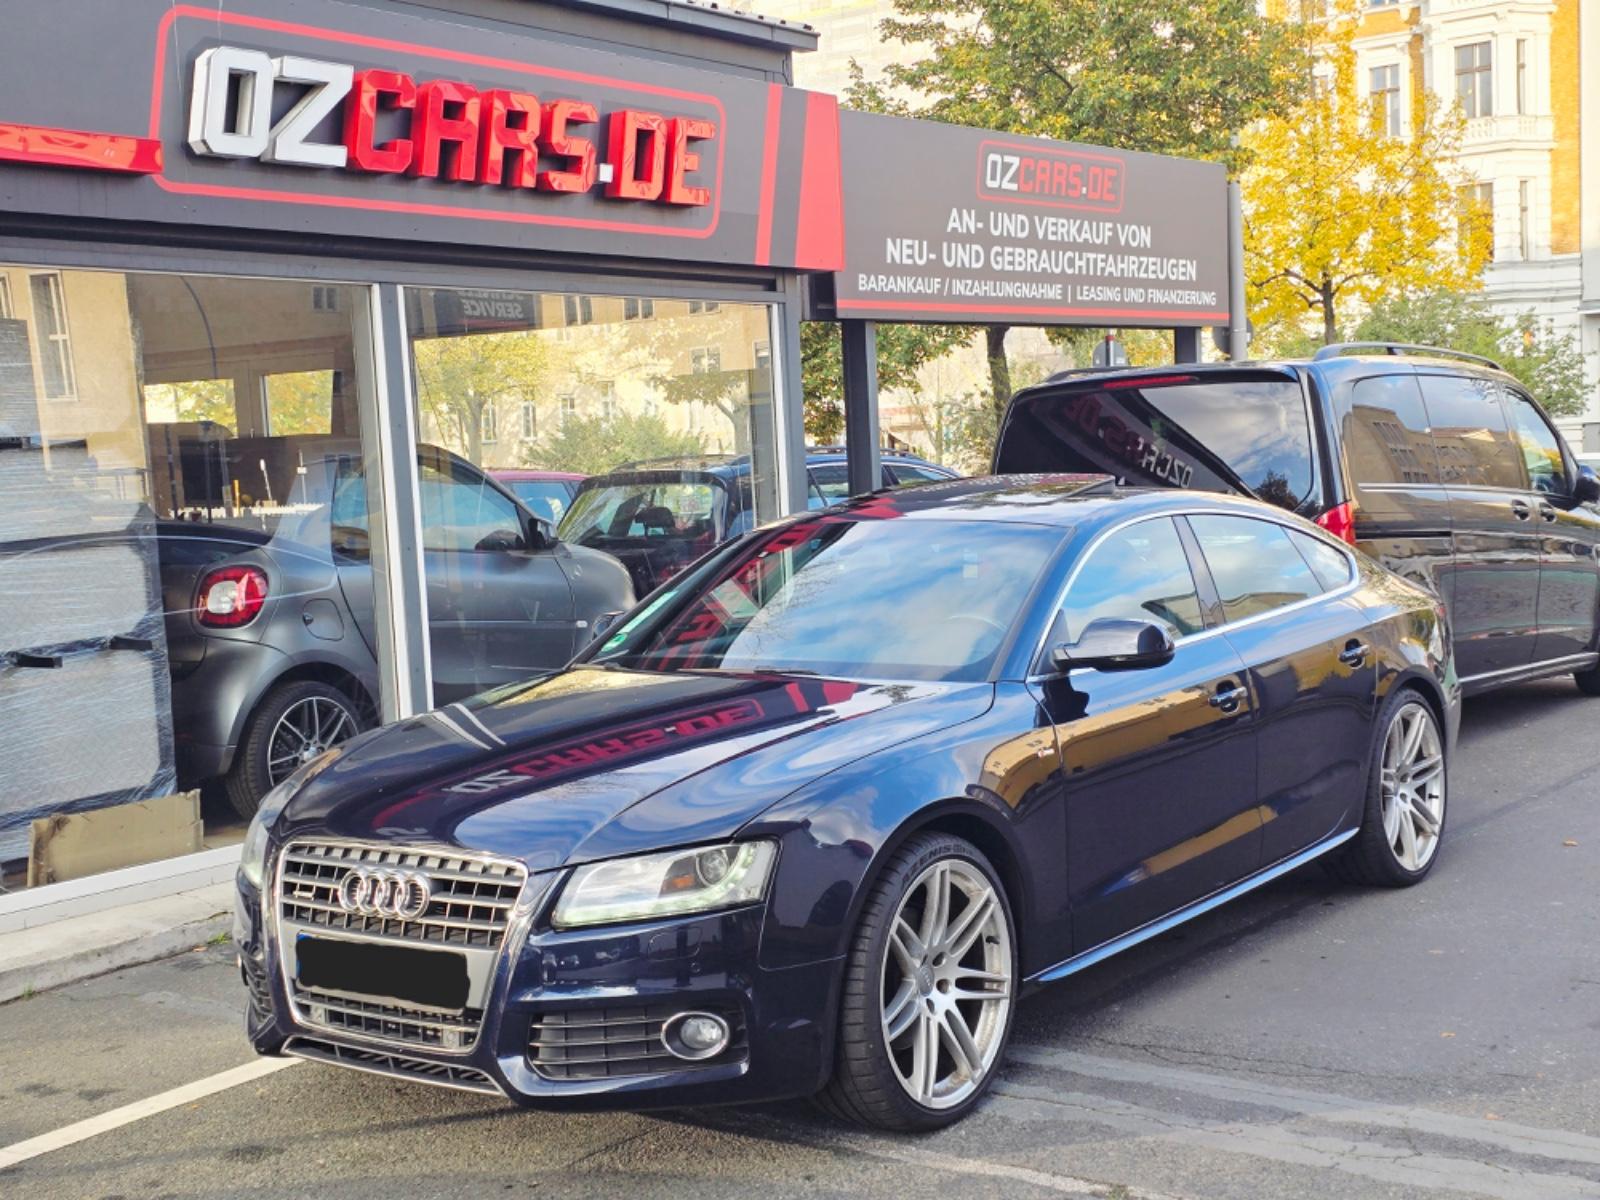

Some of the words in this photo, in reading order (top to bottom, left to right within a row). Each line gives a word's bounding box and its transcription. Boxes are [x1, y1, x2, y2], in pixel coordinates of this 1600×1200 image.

[187, 45, 717, 207] OZCARS.DE
[986, 152, 1118, 202] OZCARS.DE
[946, 207, 983, 234] AN-
[990, 211, 1030, 239] UND
[1034, 215, 1113, 245] VERKAUF
[1117, 223, 1152, 249] VON
[886, 237, 936, 266] NEU-
[942, 241, 984, 269] UND
[990, 245, 1197, 281] GEBRAUCHTFAHRZEUGEN
[858, 273, 942, 294] BARANKAUF
[951, 278, 1063, 299] INZAHLUNGNAHME
[1076, 285, 1121, 301] LEASING
[1122, 287, 1145, 303] UND
[1146, 289, 1217, 306] FINANZIERUNG
